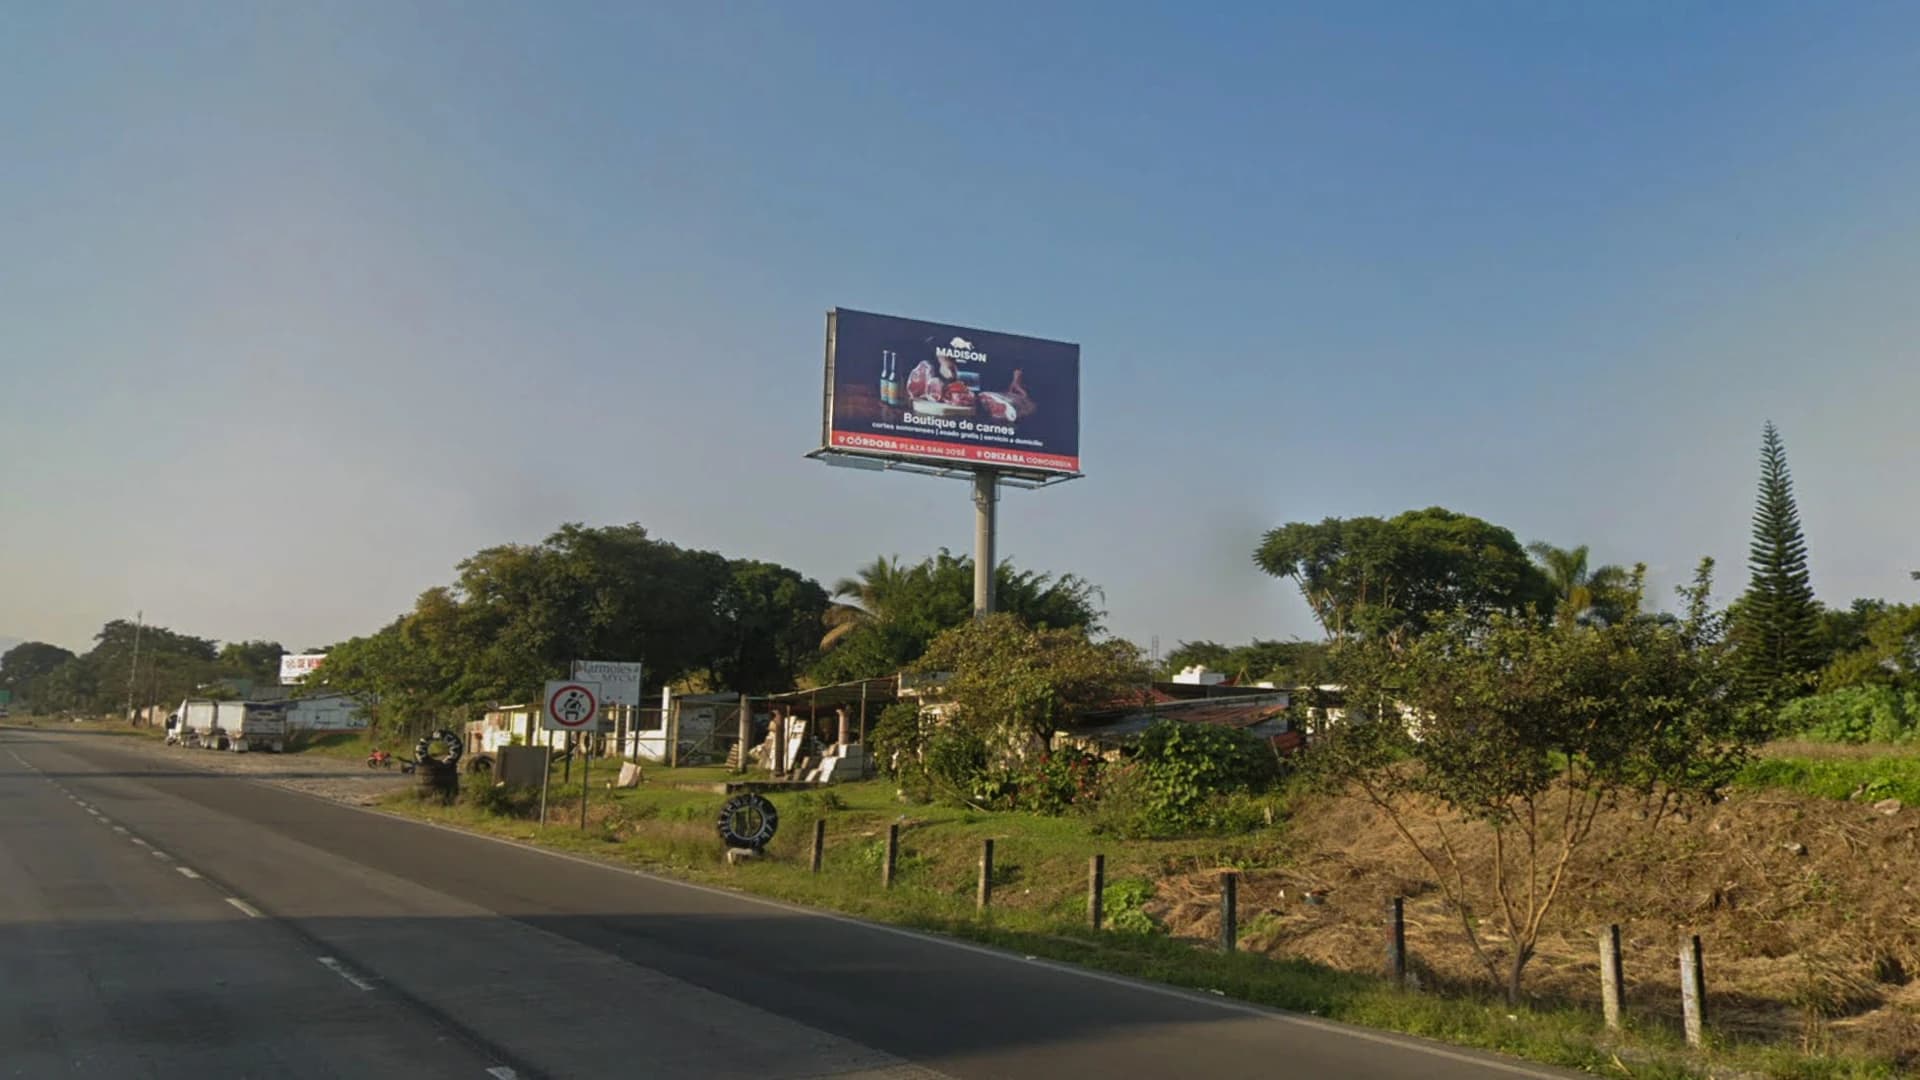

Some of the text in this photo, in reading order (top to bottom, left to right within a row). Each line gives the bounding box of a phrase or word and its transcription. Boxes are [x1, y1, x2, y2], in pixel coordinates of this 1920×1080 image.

[936, 347, 986, 362] MADISON
[872, 422, 894, 430] cortes
[904, 413, 1015, 435] Boutique de carnes
[847, 436, 966, 457] CÓRDOBA PLAZA SAN JOSÉ
[983, 450, 1025, 464] ORIZABA
